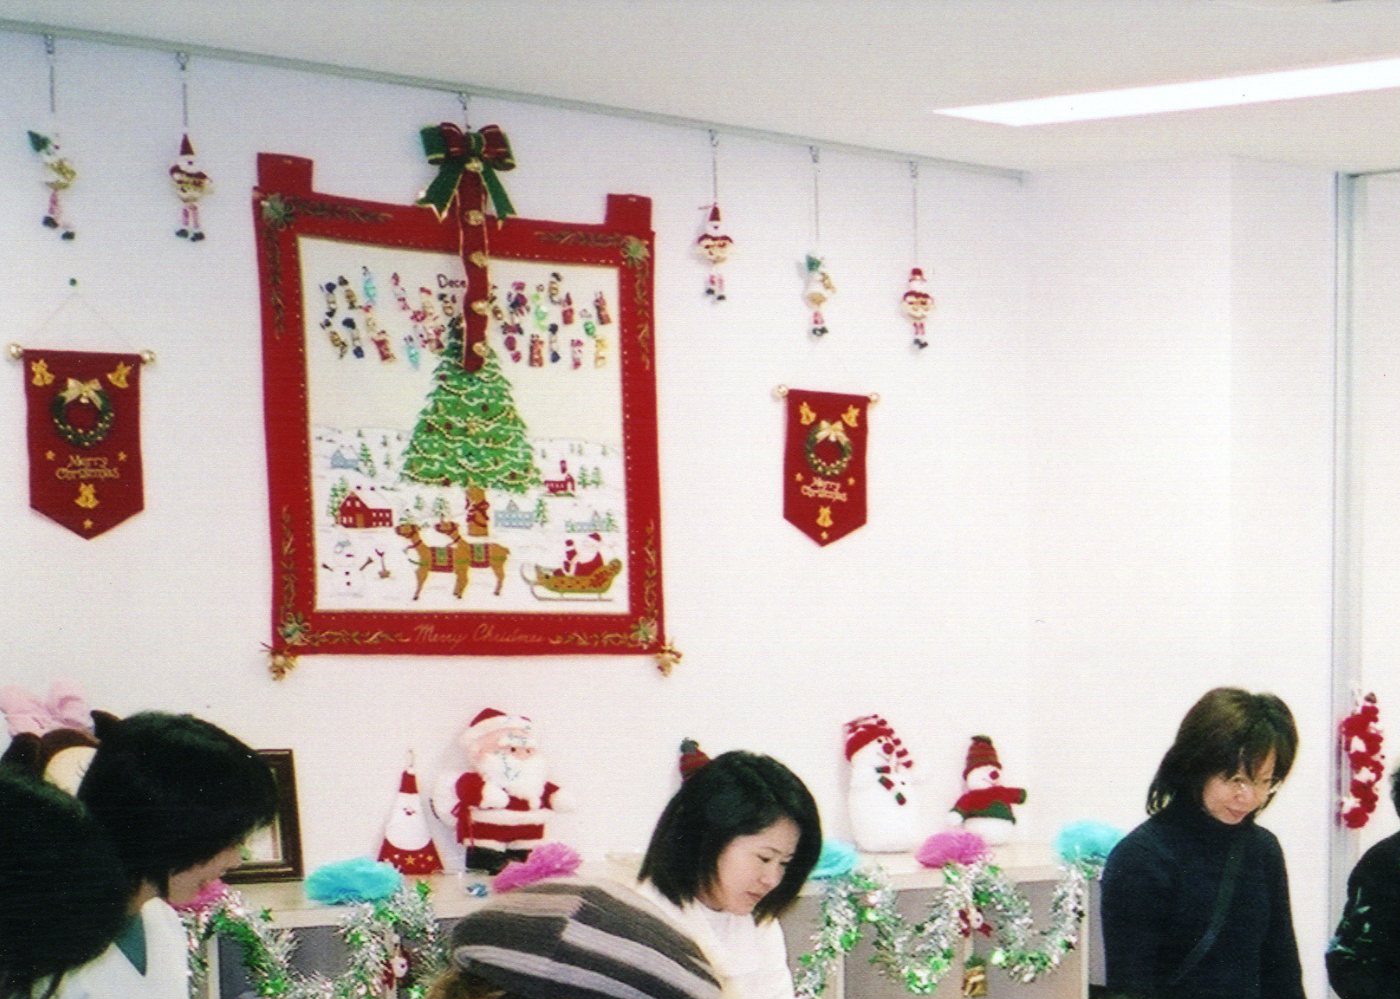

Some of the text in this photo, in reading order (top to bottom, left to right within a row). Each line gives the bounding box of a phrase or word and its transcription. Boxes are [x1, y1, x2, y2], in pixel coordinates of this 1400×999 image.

[437, 273, 467, 289] Dece
[67, 454, 109, 469] Merry
[55, 466, 120, 480] Christmas
